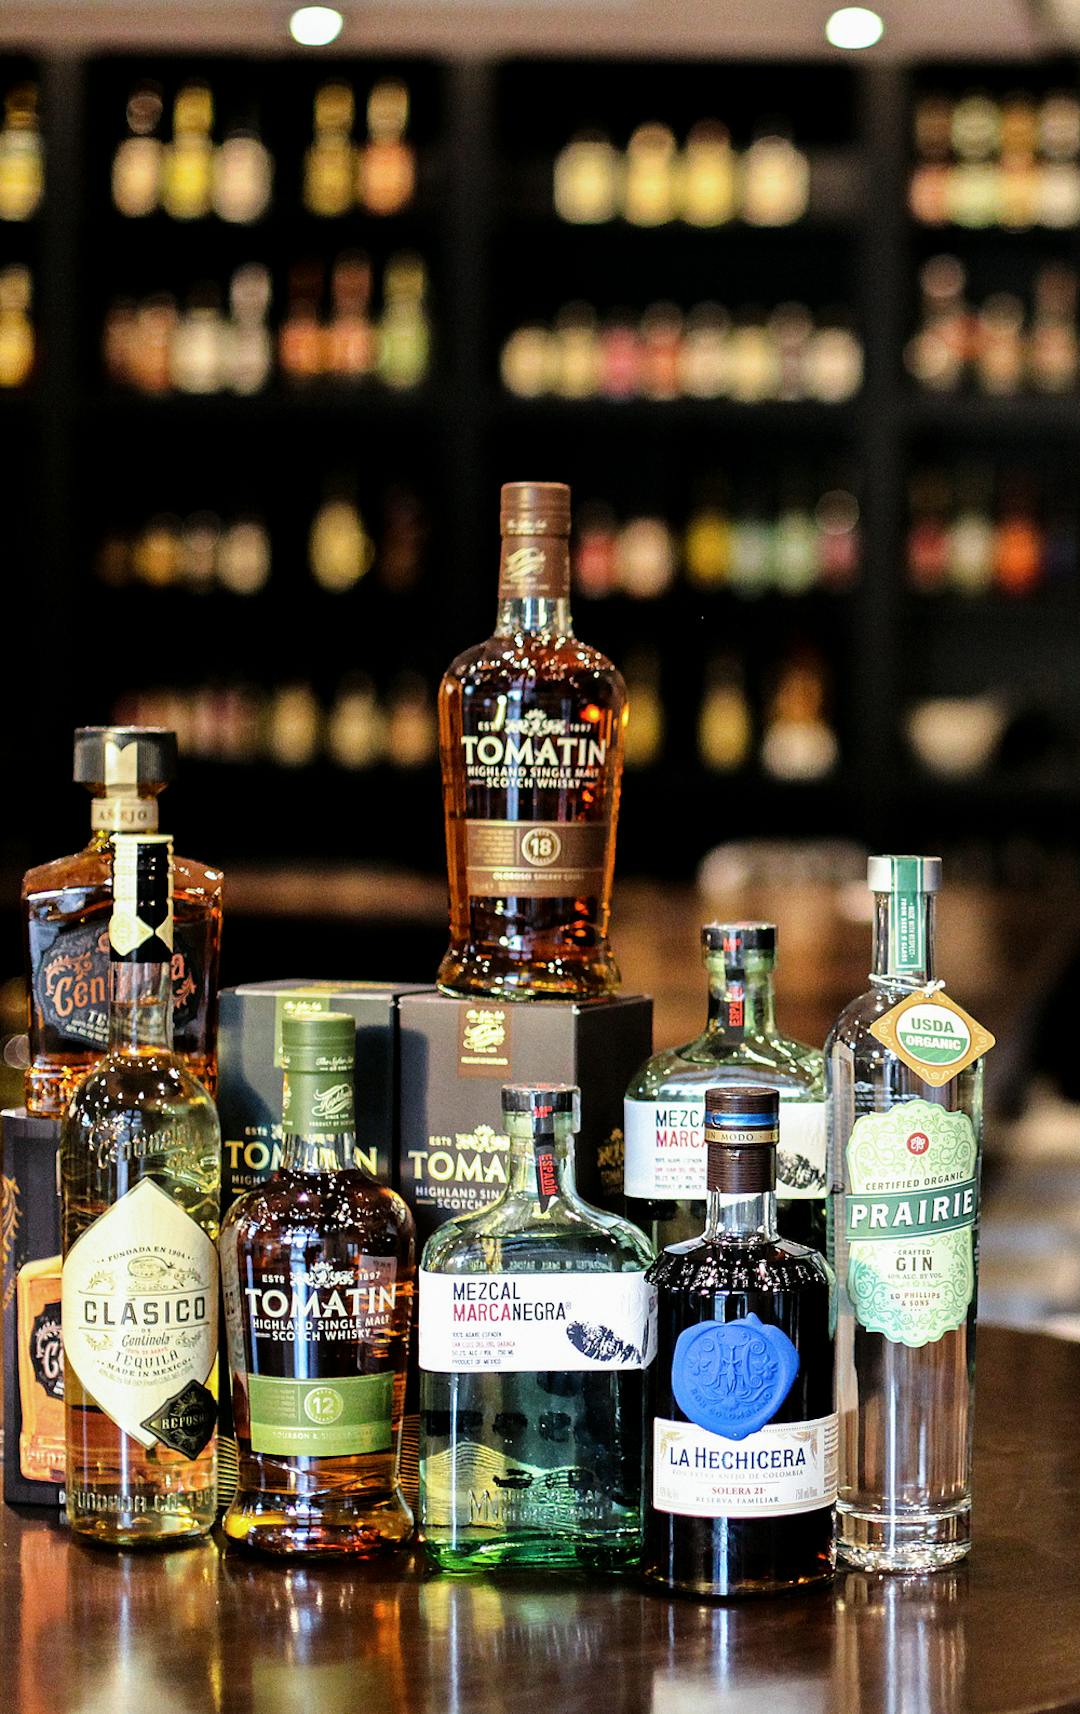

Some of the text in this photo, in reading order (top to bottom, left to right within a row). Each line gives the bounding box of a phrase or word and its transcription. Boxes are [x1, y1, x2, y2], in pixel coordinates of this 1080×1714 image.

[461, 735, 606, 766] TOMATIN
[467, 766, 527, 778] HIGHLAND
[530, 767, 572, 779] SINGLE
[486, 778, 581, 789] SCOTCH WHISKY
[530, 838, 553, 857] 18
[911, 1018, 954, 1034] USDA
[905, 1035, 961, 1052] ORGANIC
[721, 1132, 754, 1141] MODO
[865, 1170, 964, 1191] CERTIFIED ORGANIC
[416, 1185, 477, 1198] HIGHLAND
[851, 1188, 975, 1229] PRAIRIE
[108, 1246, 151, 1262] FUNDADA
[896, 1257, 932, 1271] GIN
[453, 1281, 521, 1301] MEZCAL
[904, 1291, 941, 1299] PHILLIPS
[245, 1283, 397, 1318] TOMATIN
[84, 1296, 206, 1326] CLÁSICO
[253, 1314, 390, 1331] HIGHLAND SINGLE MALT
[272, 1328, 371, 1341] SCOTCH WHISKY
[107, 1362, 135, 1377] MADE
[152, 1358, 189, 1377] MEXICO
[115, 1349, 179, 1369] TEQUILA
[312, 1397, 335, 1415] 12
[670, 1446, 806, 1470] LA HECHICERA
[763, 1469, 804, 1479] COLOMBIA
[711, 1486, 751, 1495] SOLERA
[736, 1495, 780, 1504] FAMILIAR
